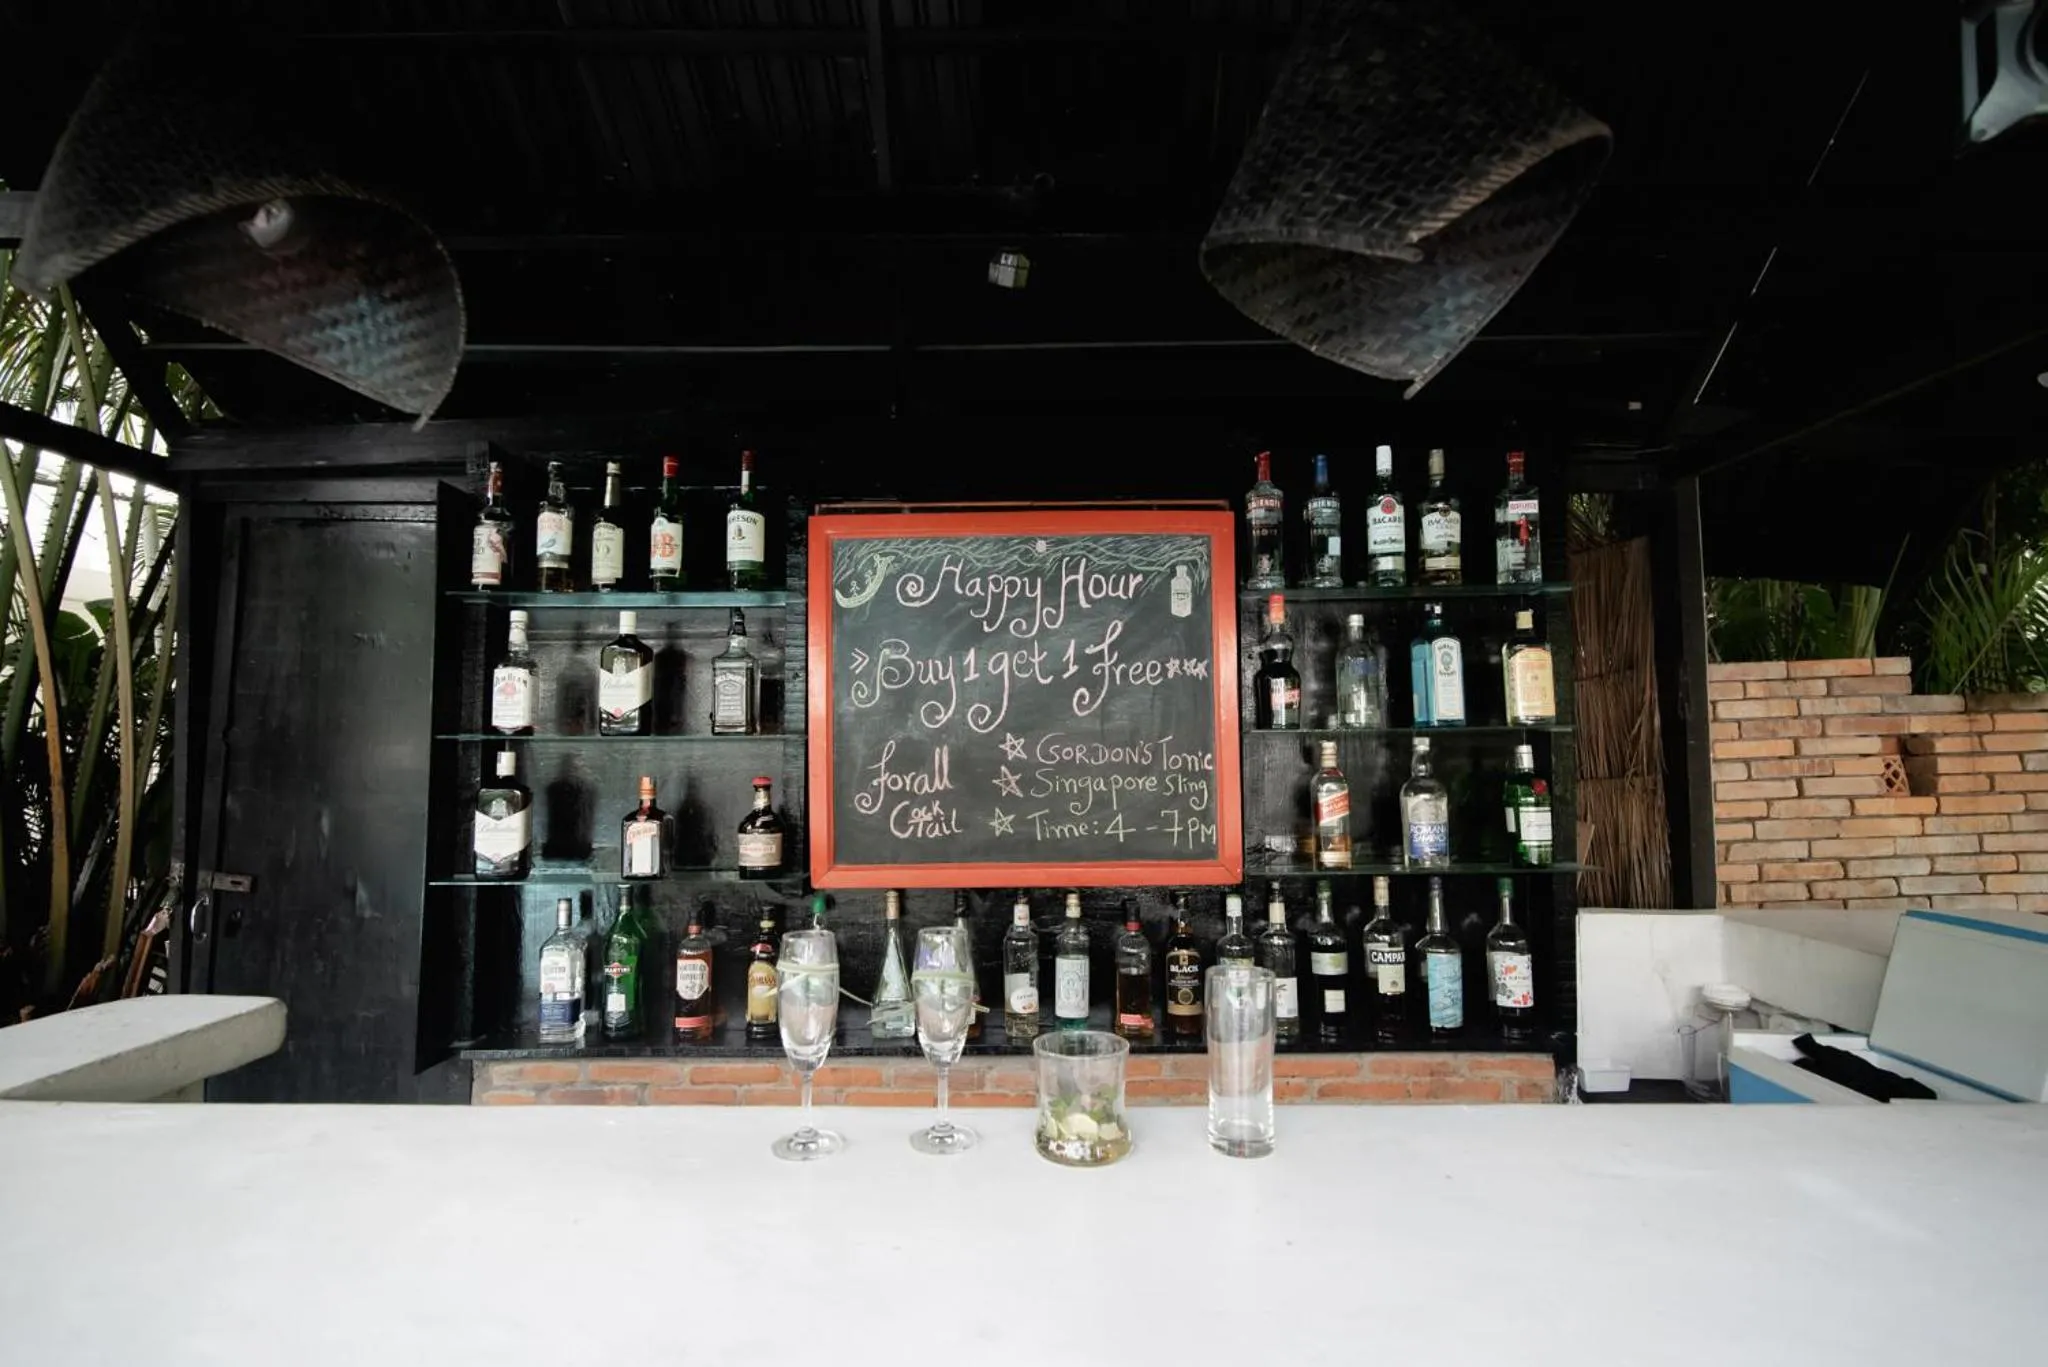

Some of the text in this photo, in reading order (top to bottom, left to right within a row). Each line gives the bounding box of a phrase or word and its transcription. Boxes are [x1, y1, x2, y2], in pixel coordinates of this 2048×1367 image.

[896, 554, 1144, 638] Happy Hour
[963, 647, 980, 682] 1
[1062, 639, 1080, 678] 1
[852, 639, 956, 728] Buy
[967, 640, 1053, 732] get
[1036, 732, 1214, 771] GORDON'S Tonic
[1030, 768, 1209, 816] Singapore Sling
[1027, 808, 1099, 841] Time:
[1104, 812, 1137, 843] 4
[1170, 964, 1199, 973] BLACK
